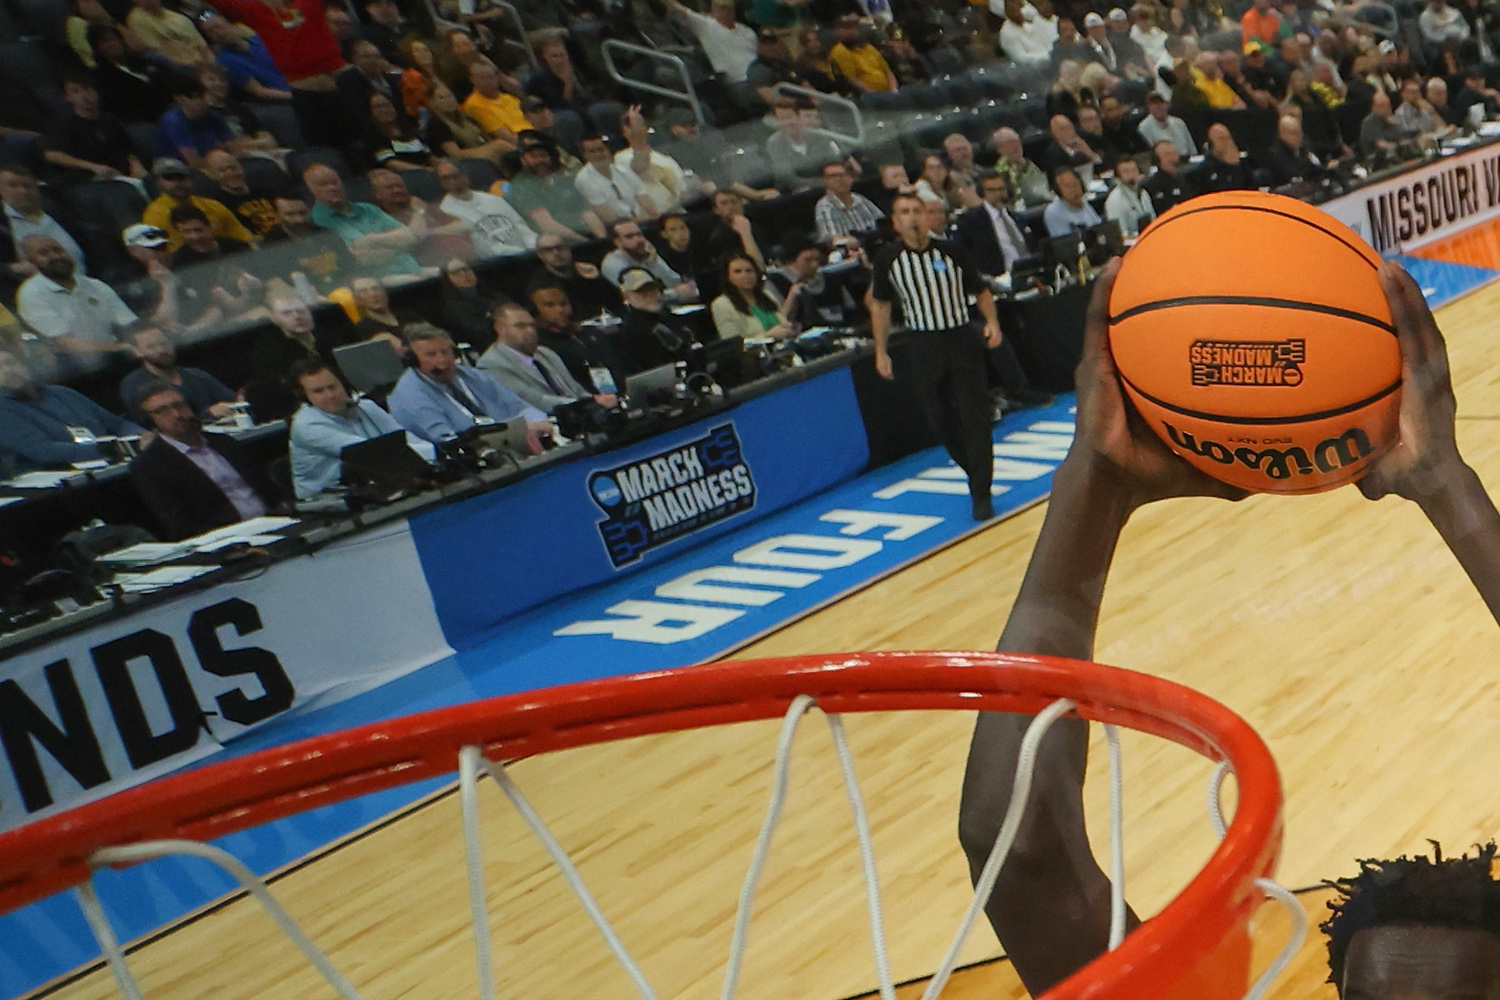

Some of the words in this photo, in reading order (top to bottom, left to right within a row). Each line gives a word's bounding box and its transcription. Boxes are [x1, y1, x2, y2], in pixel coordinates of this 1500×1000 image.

[1366, 163, 1480, 253] MISSOURI
[1190, 346, 1274, 366] MADNESS
[1220, 365, 1284, 385] MARCH
[616, 446, 705, 504] MARCH
[1161, 420, 1376, 480] Wilson
[642, 463, 753, 532] MADNESS
[553, 509, 946, 645] FOUR
[0, 597, 296, 814] NDS
